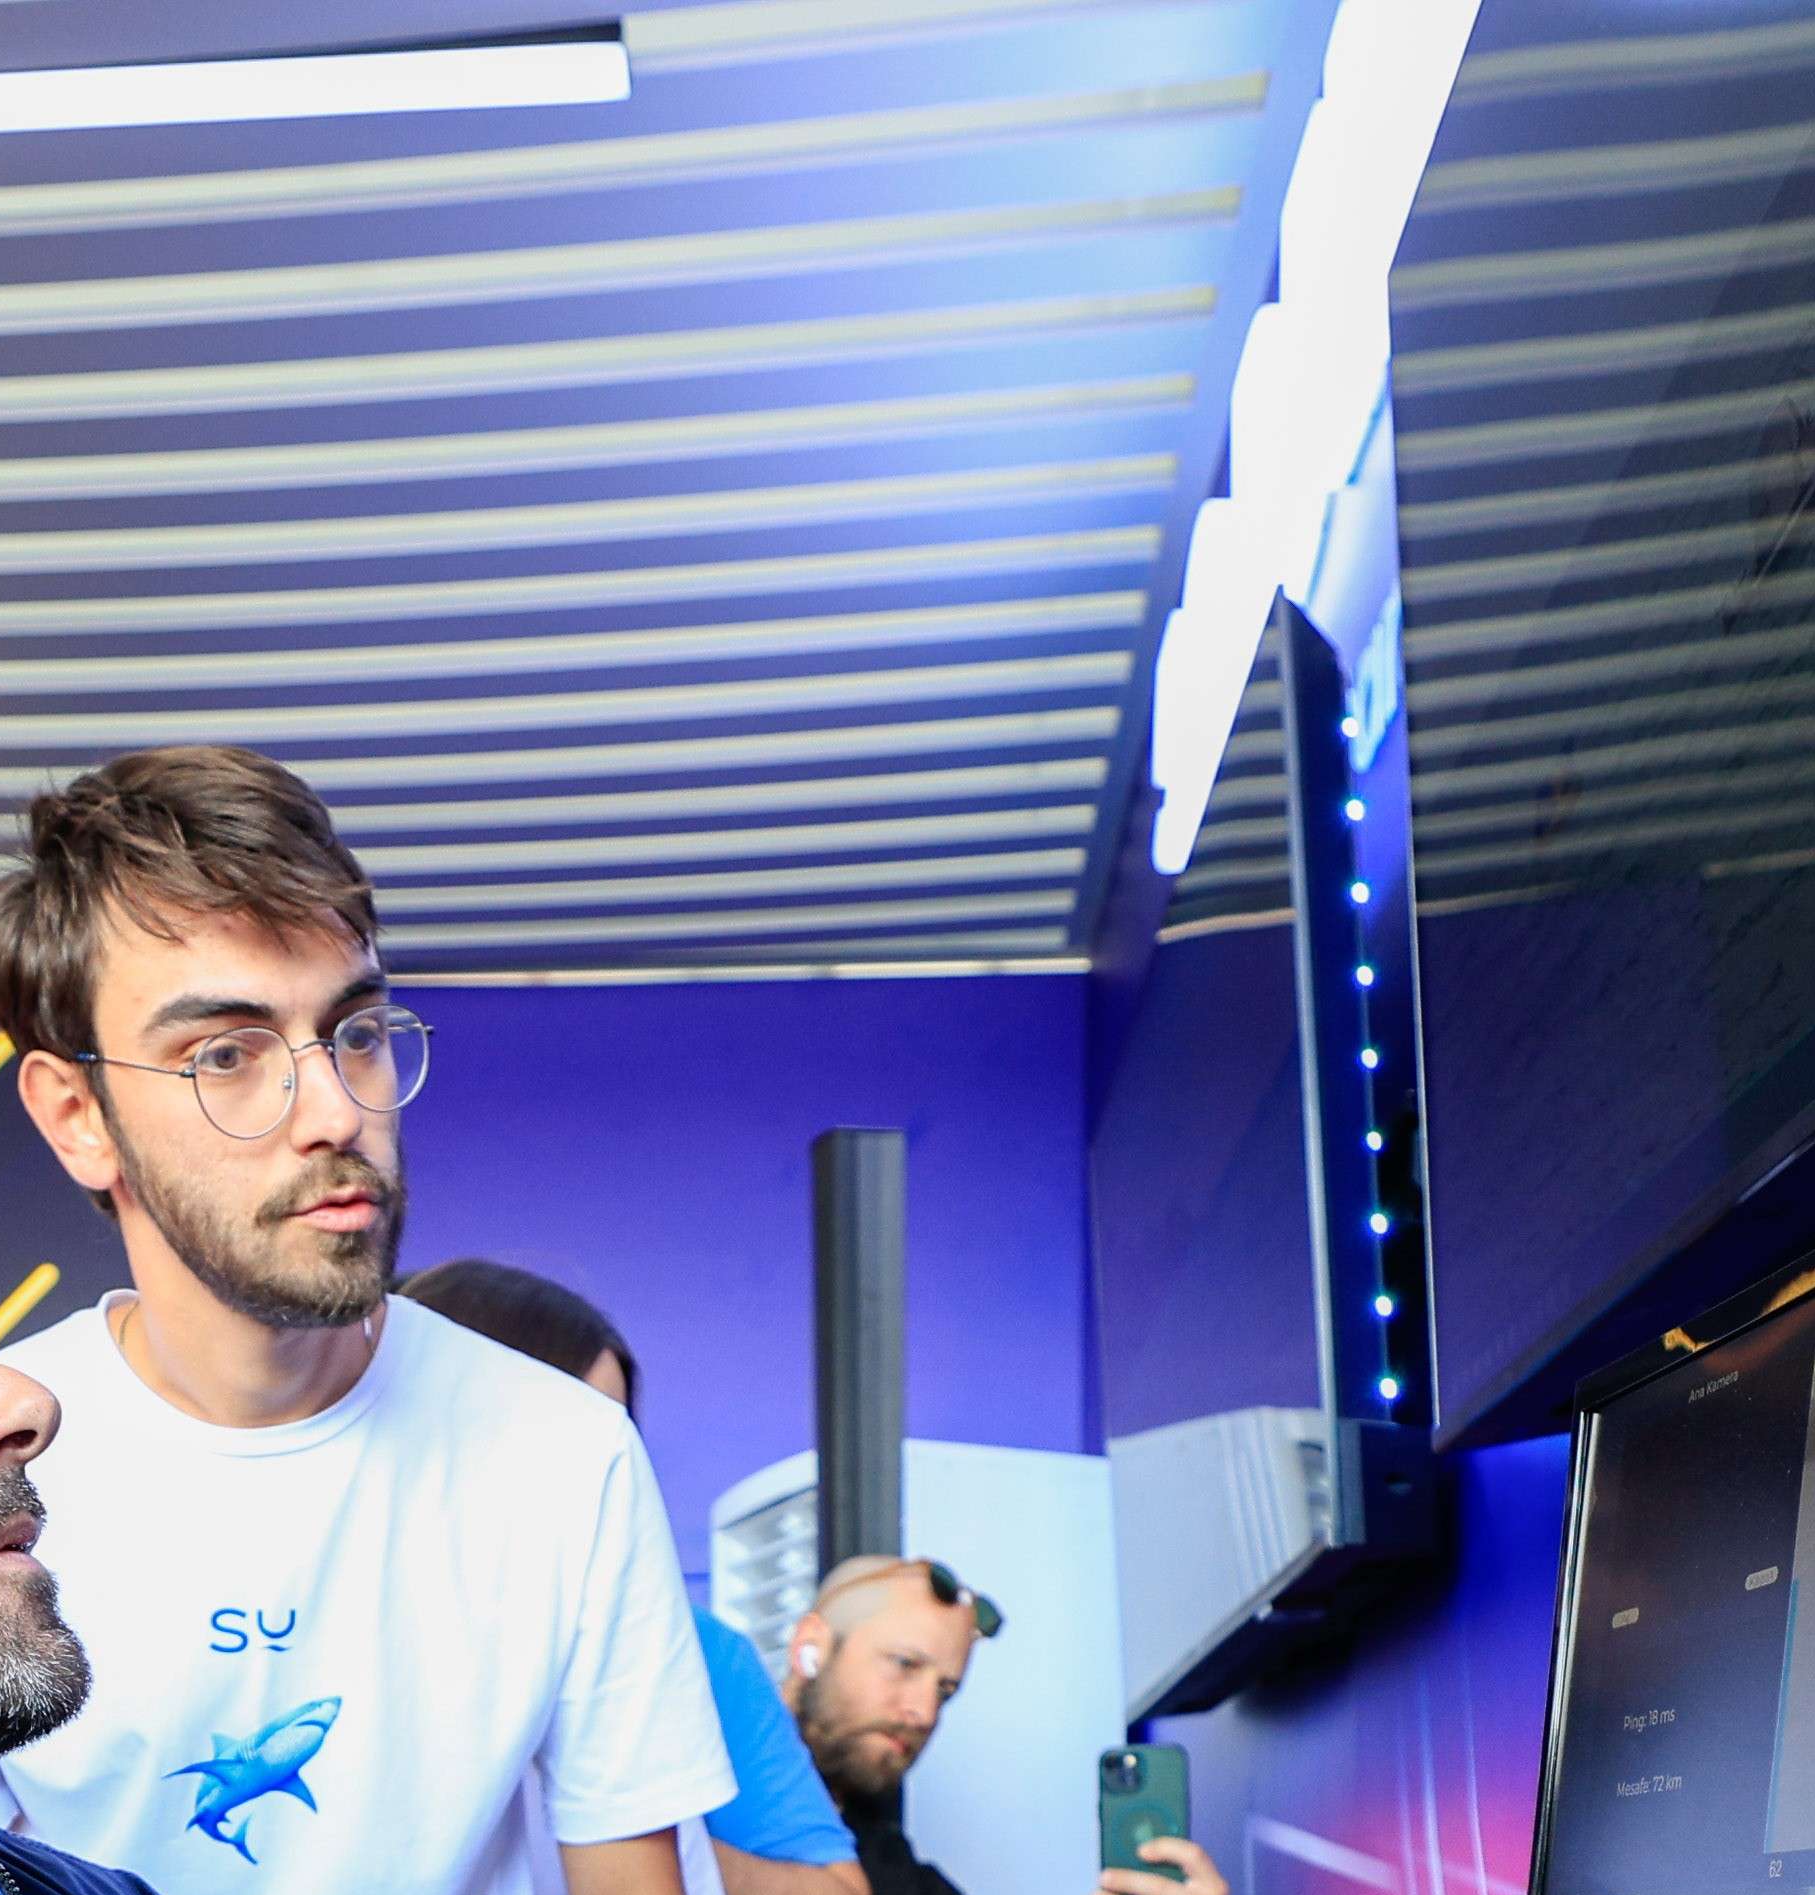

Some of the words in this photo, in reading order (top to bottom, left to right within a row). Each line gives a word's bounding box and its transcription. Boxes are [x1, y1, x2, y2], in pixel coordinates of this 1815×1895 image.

[209, 1607, 297, 1654] SU
[1623, 1714, 1648, 1733] Ping:
[1659, 1708, 1677, 1725] ms
[1616, 1776, 1651, 1798] Mesafe:
[1652, 1774, 1664, 1793] 72
[1665, 1773, 1683, 1792] km
[1768, 1859, 1783, 1879] 62
